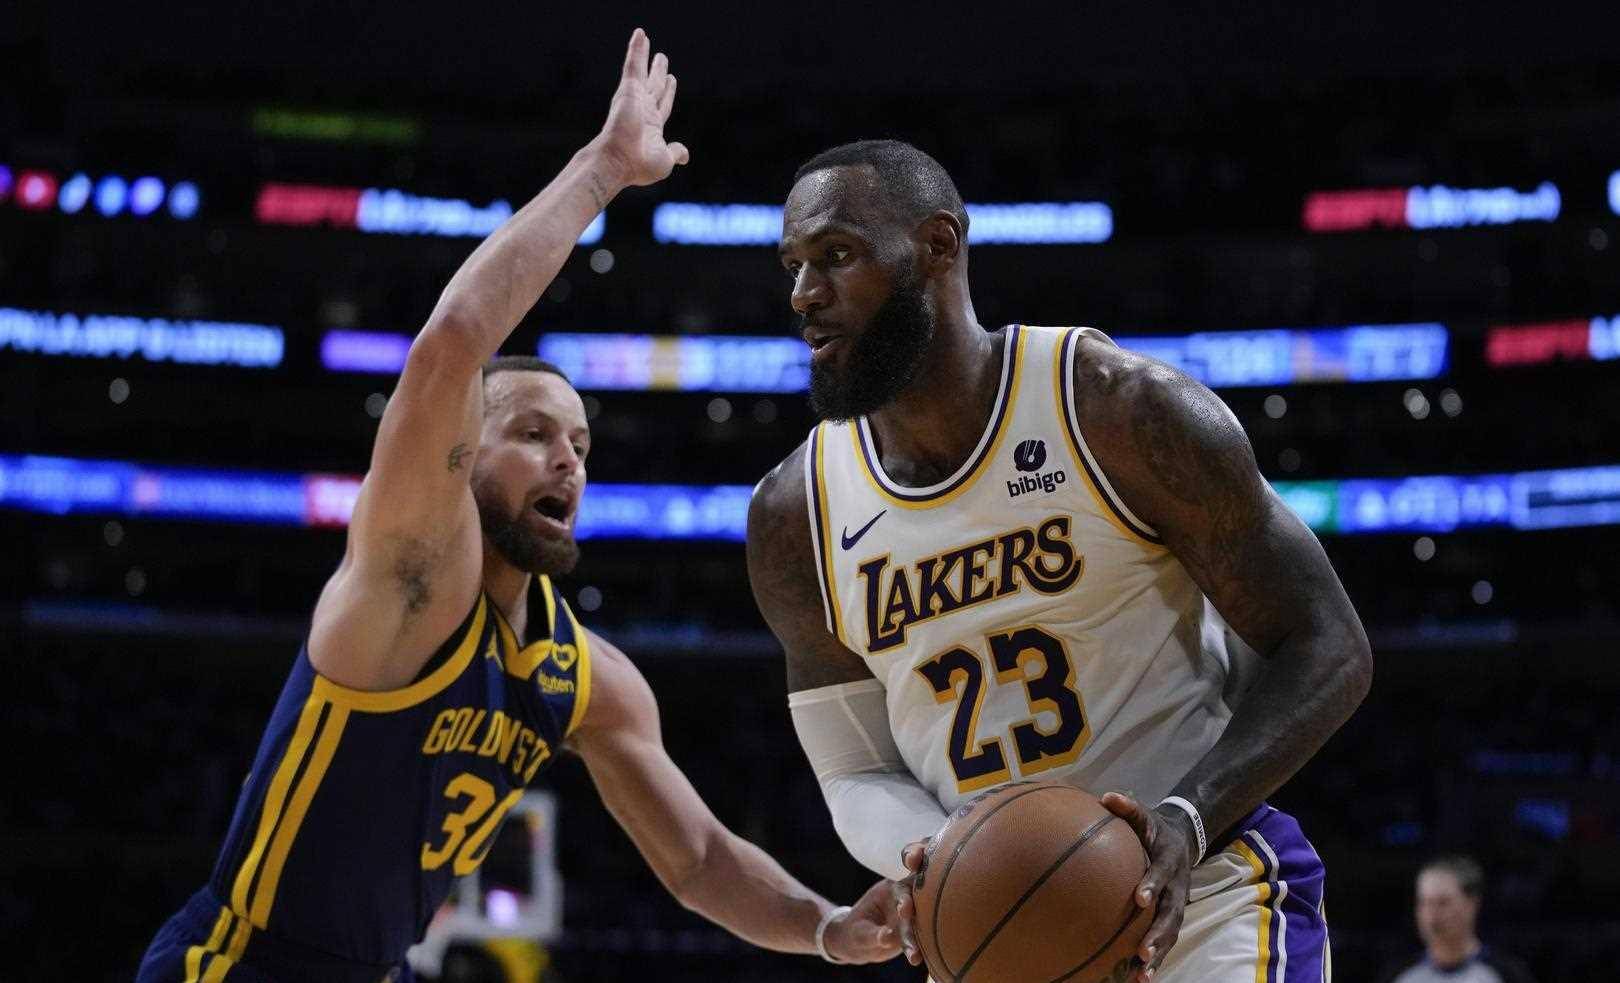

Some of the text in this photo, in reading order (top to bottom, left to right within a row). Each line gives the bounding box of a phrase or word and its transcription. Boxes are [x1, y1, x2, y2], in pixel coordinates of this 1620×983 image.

[1007, 470, 1066, 498] bibigo
[856, 515, 1085, 655] LAKERS
[423, 707, 521, 763] GOLDN
[912, 623, 1092, 793] 23
[421, 772, 525, 876] 30
